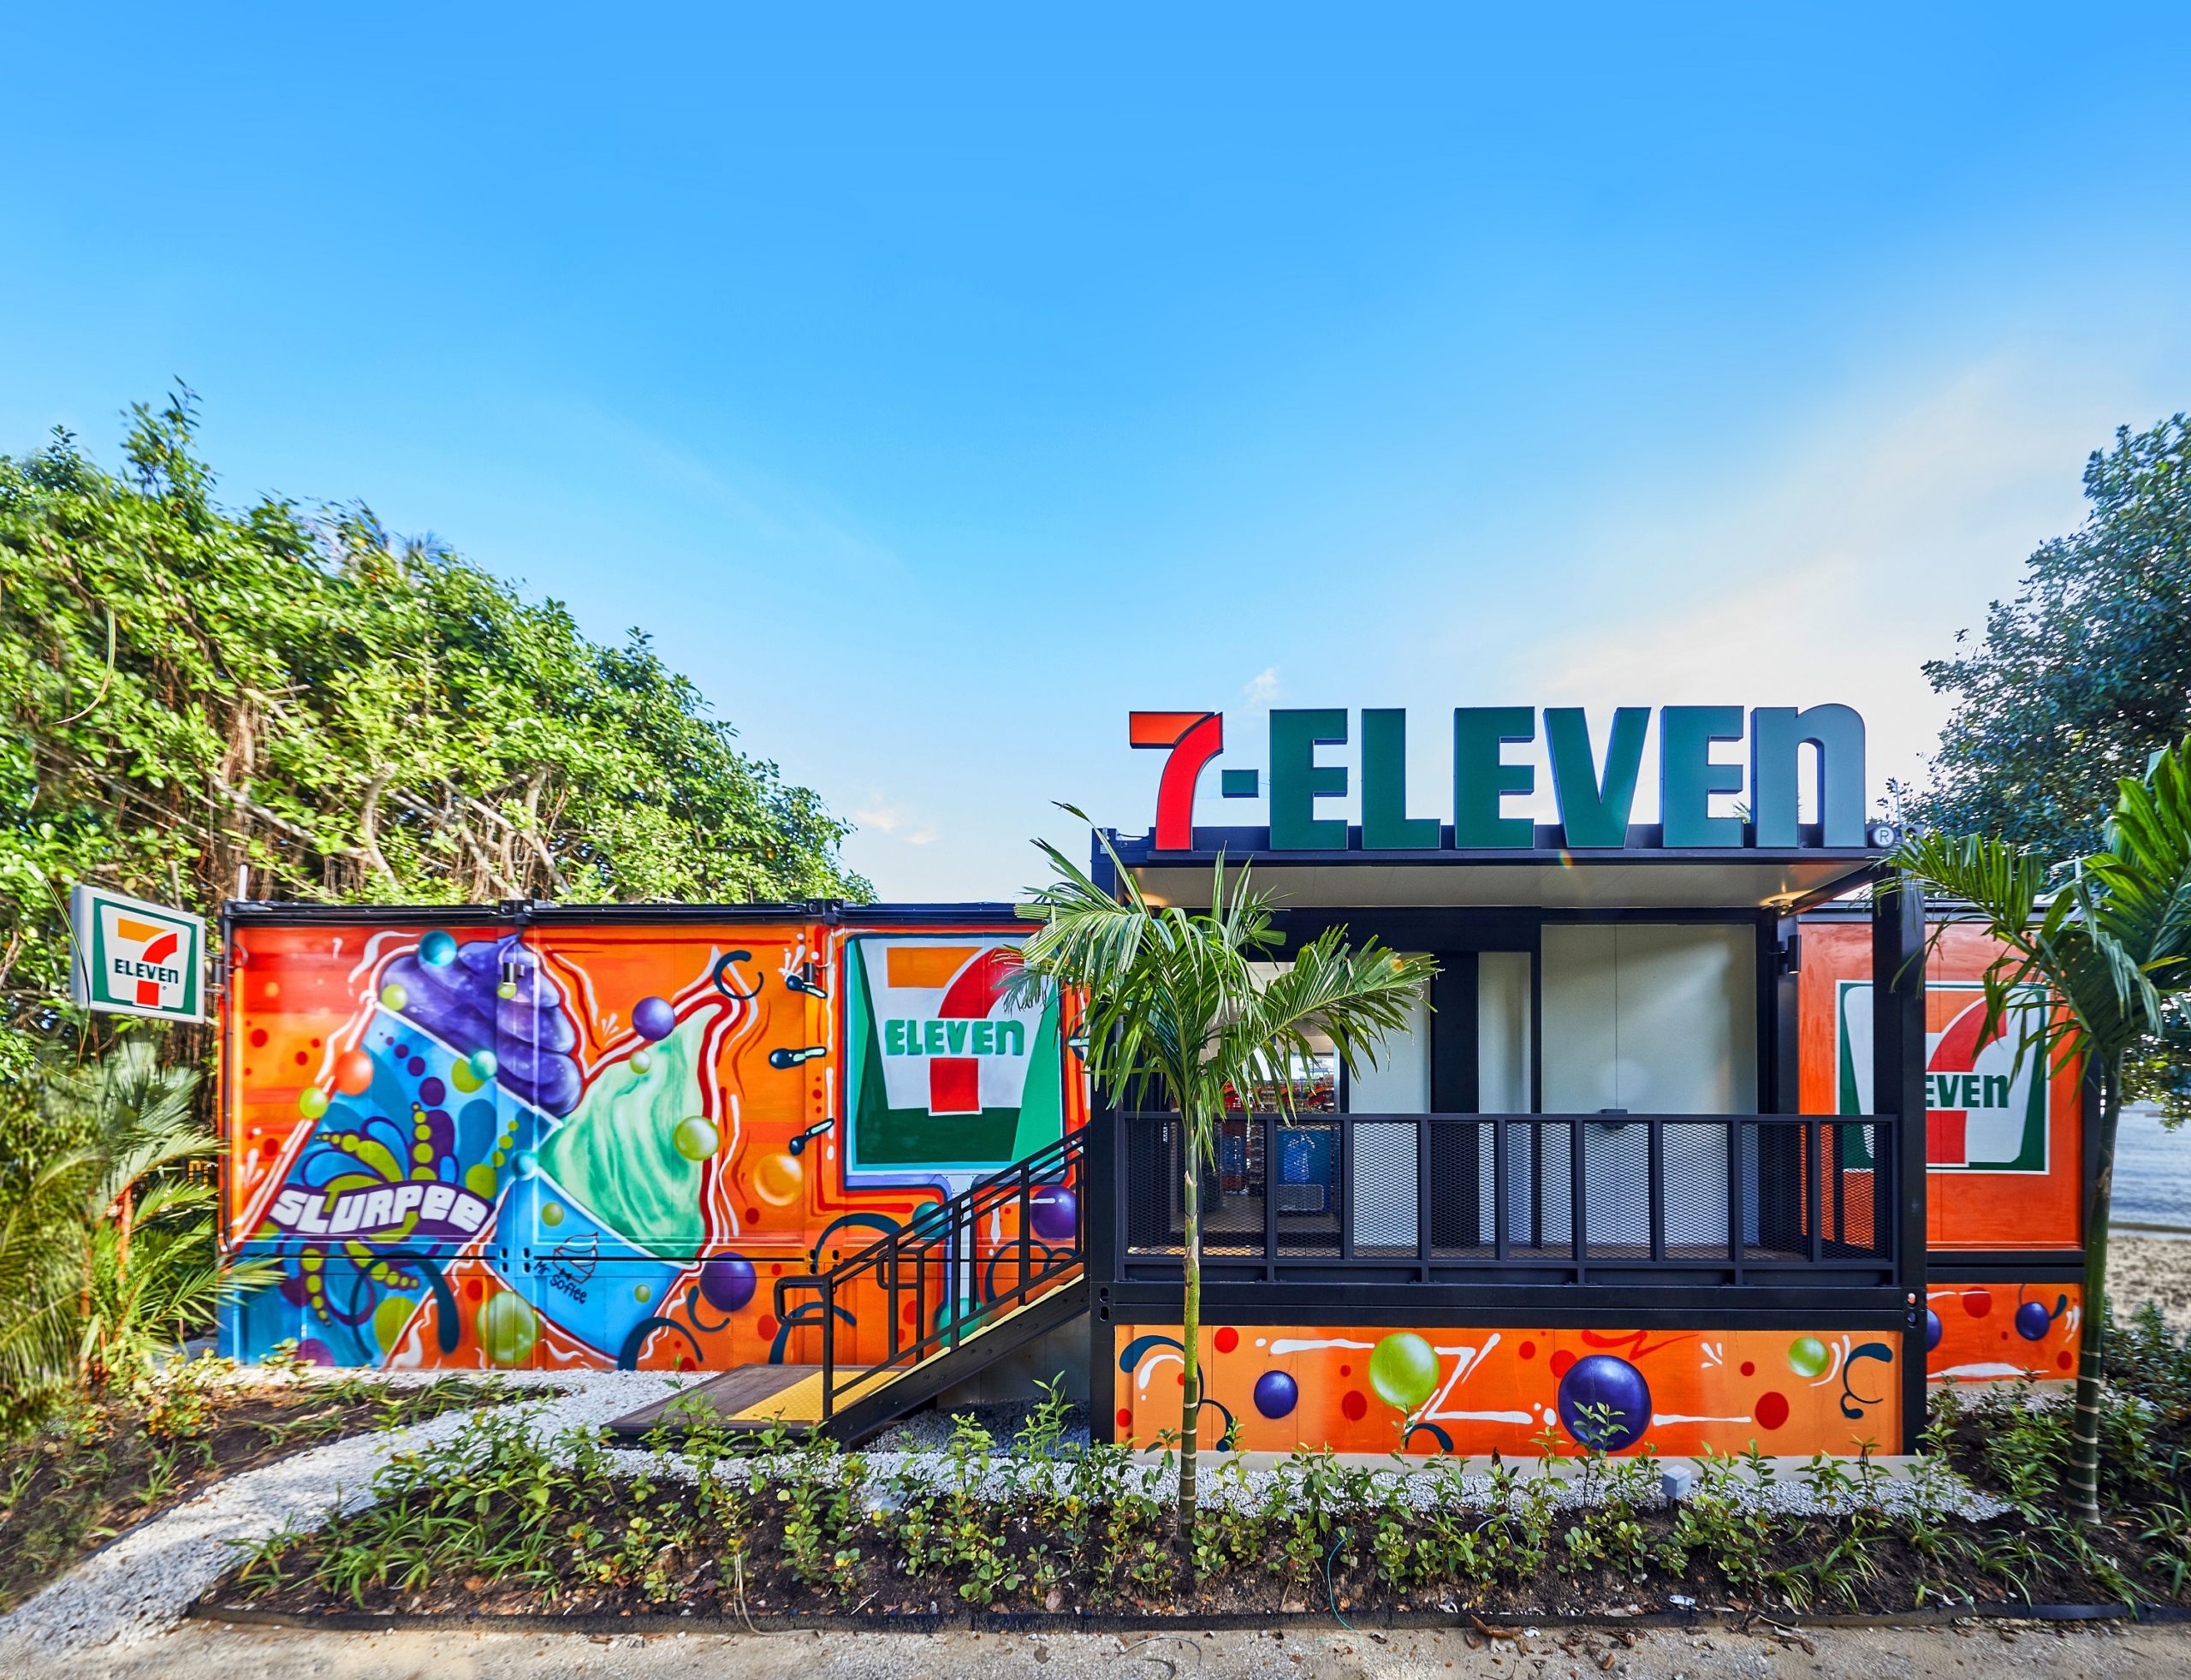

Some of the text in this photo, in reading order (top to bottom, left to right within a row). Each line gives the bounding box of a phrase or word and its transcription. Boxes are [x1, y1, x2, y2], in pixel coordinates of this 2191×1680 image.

[118, 918, 177, 1006] 7
[887, 947, 1024, 1113] 7
[1926, 1075, 2009, 1107] EVEn
